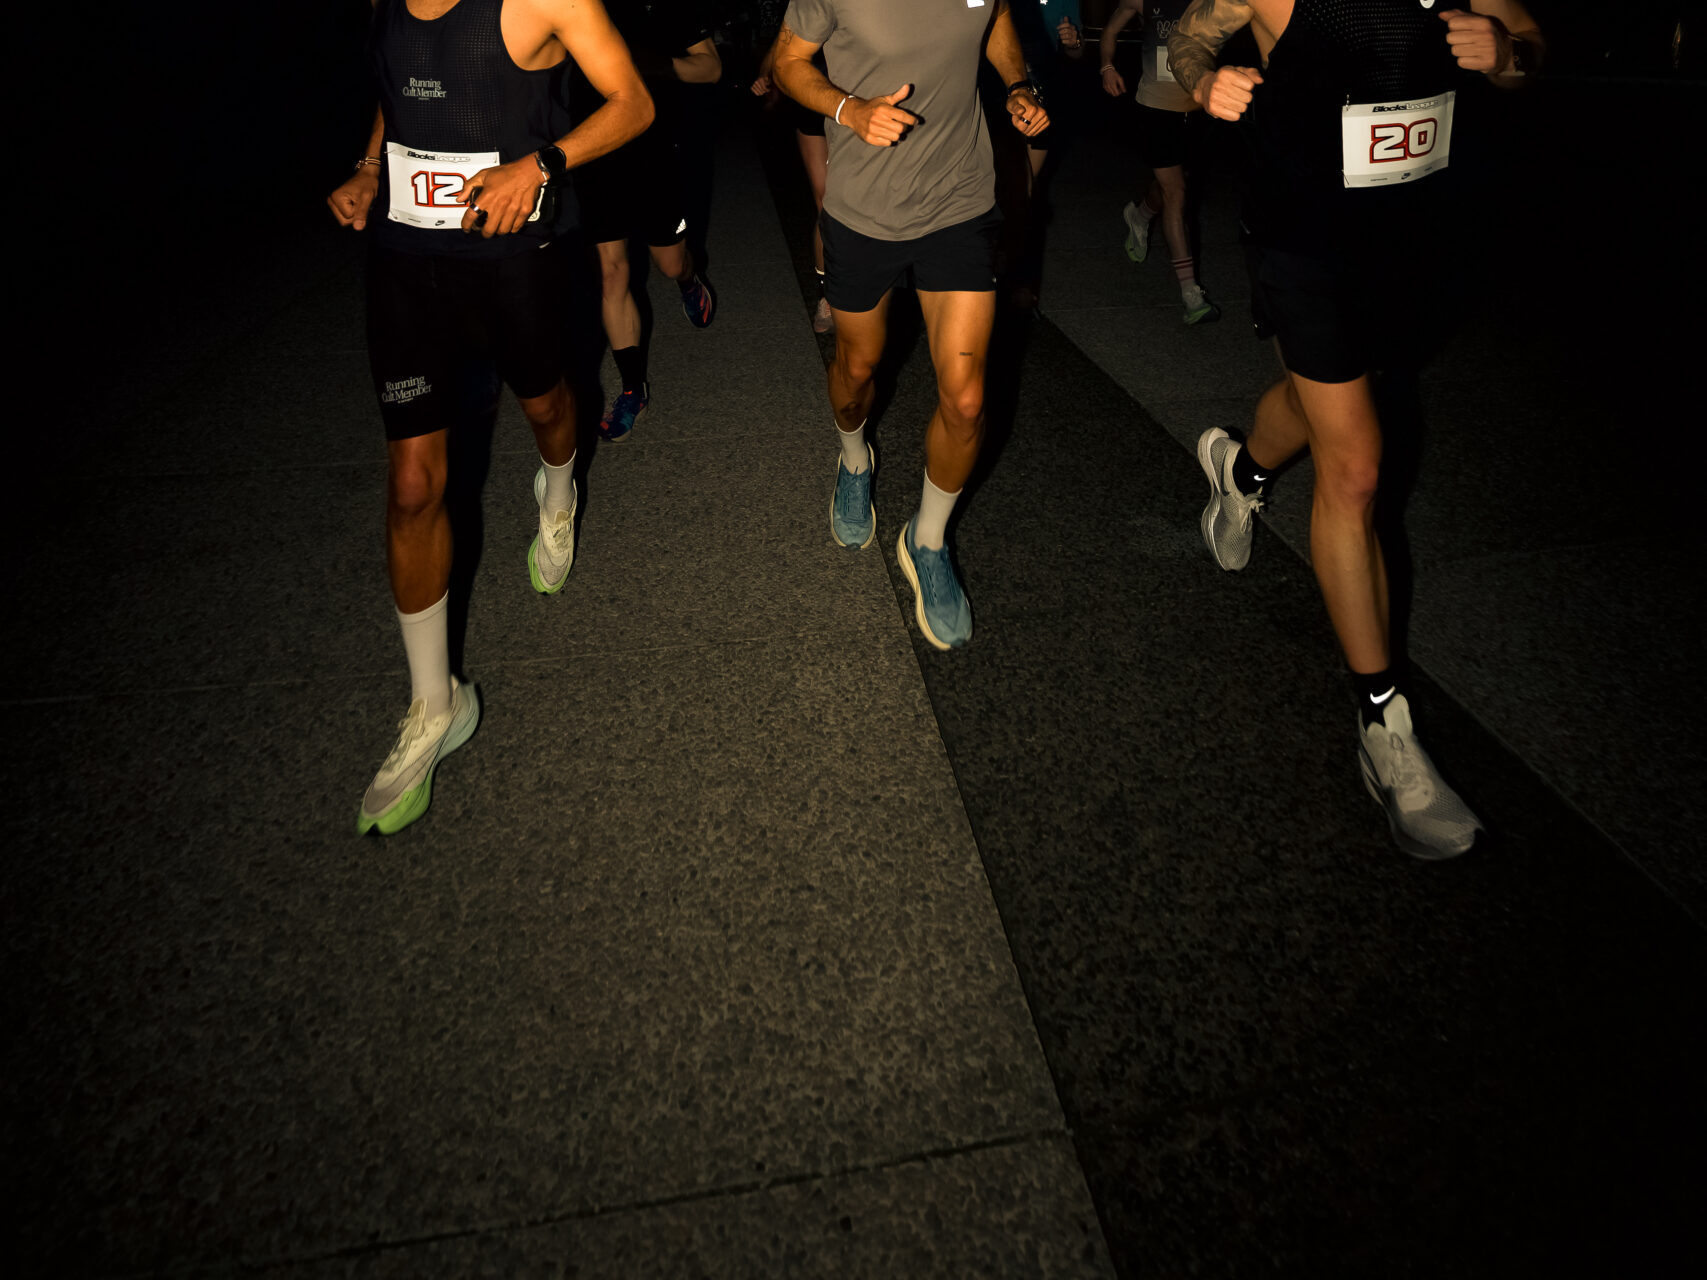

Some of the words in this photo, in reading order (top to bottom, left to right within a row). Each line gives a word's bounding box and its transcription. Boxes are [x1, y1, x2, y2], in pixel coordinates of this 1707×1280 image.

[410, 78, 441, 90] Running
[403, 87, 416, 97] Cult
[417, 88, 446, 98] Member
[1369, 117, 1437, 164] 20
[411, 170, 470, 208] 12
[385, 376, 425, 391] Running
[382, 391, 395, 402] Cult
[395, 384, 432, 400] Member
